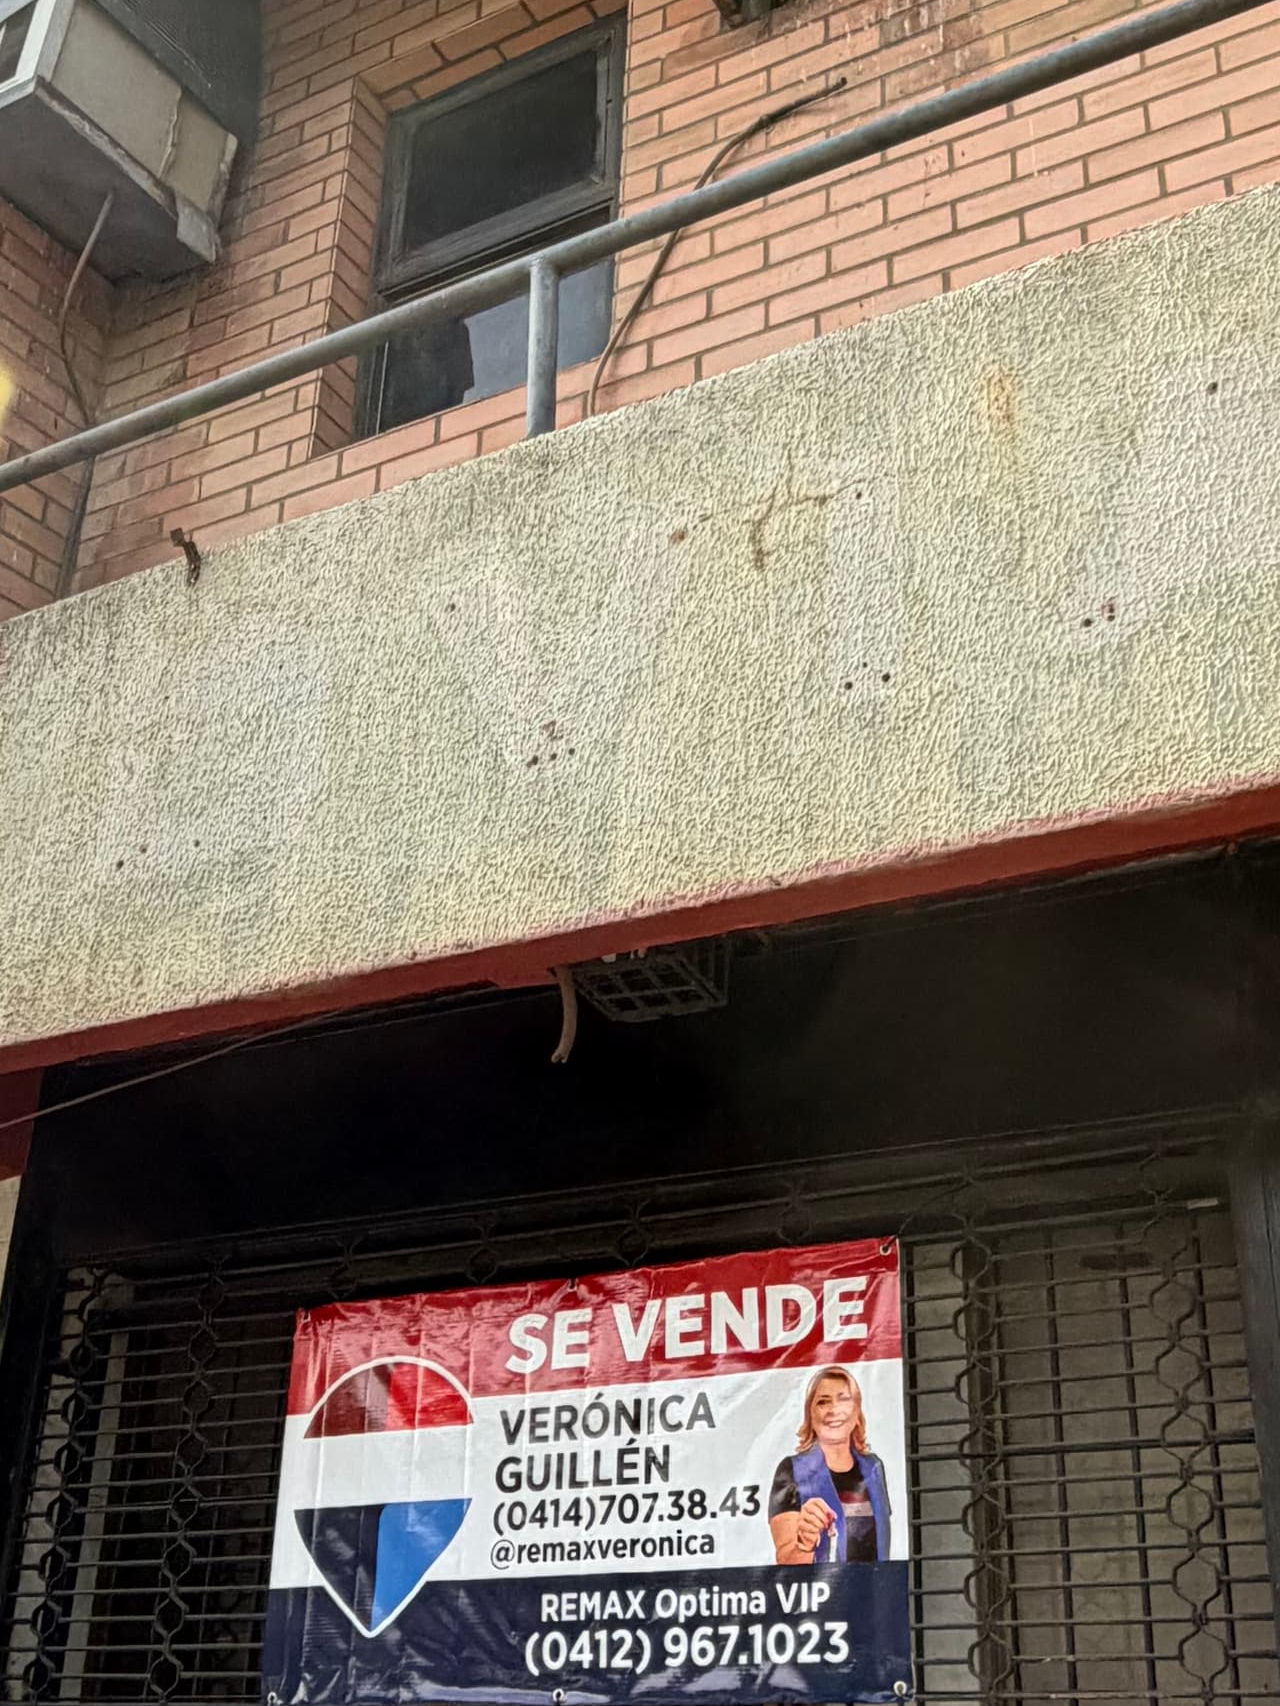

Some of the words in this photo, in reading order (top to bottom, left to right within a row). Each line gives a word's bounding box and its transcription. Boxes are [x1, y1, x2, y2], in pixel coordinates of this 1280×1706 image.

[506, 1309, 592, 1375] SE
[612, 1275, 868, 1363] VENDE
[500, 1391, 717, 1446] VERÓNICA
[495, 1438, 670, 1493] GUILLÉN
[493, 1484, 761, 1536] (0414)707.38.43
[489, 1530, 716, 1570] @remaxveronica
[541, 1589, 647, 1623] REMAX
[656, 1585, 766, 1624] Optima
[775, 1582, 832, 1615] VIP
[524, 1628, 652, 1676] (0412)
[663, 1620, 851, 1667] 967.1023
